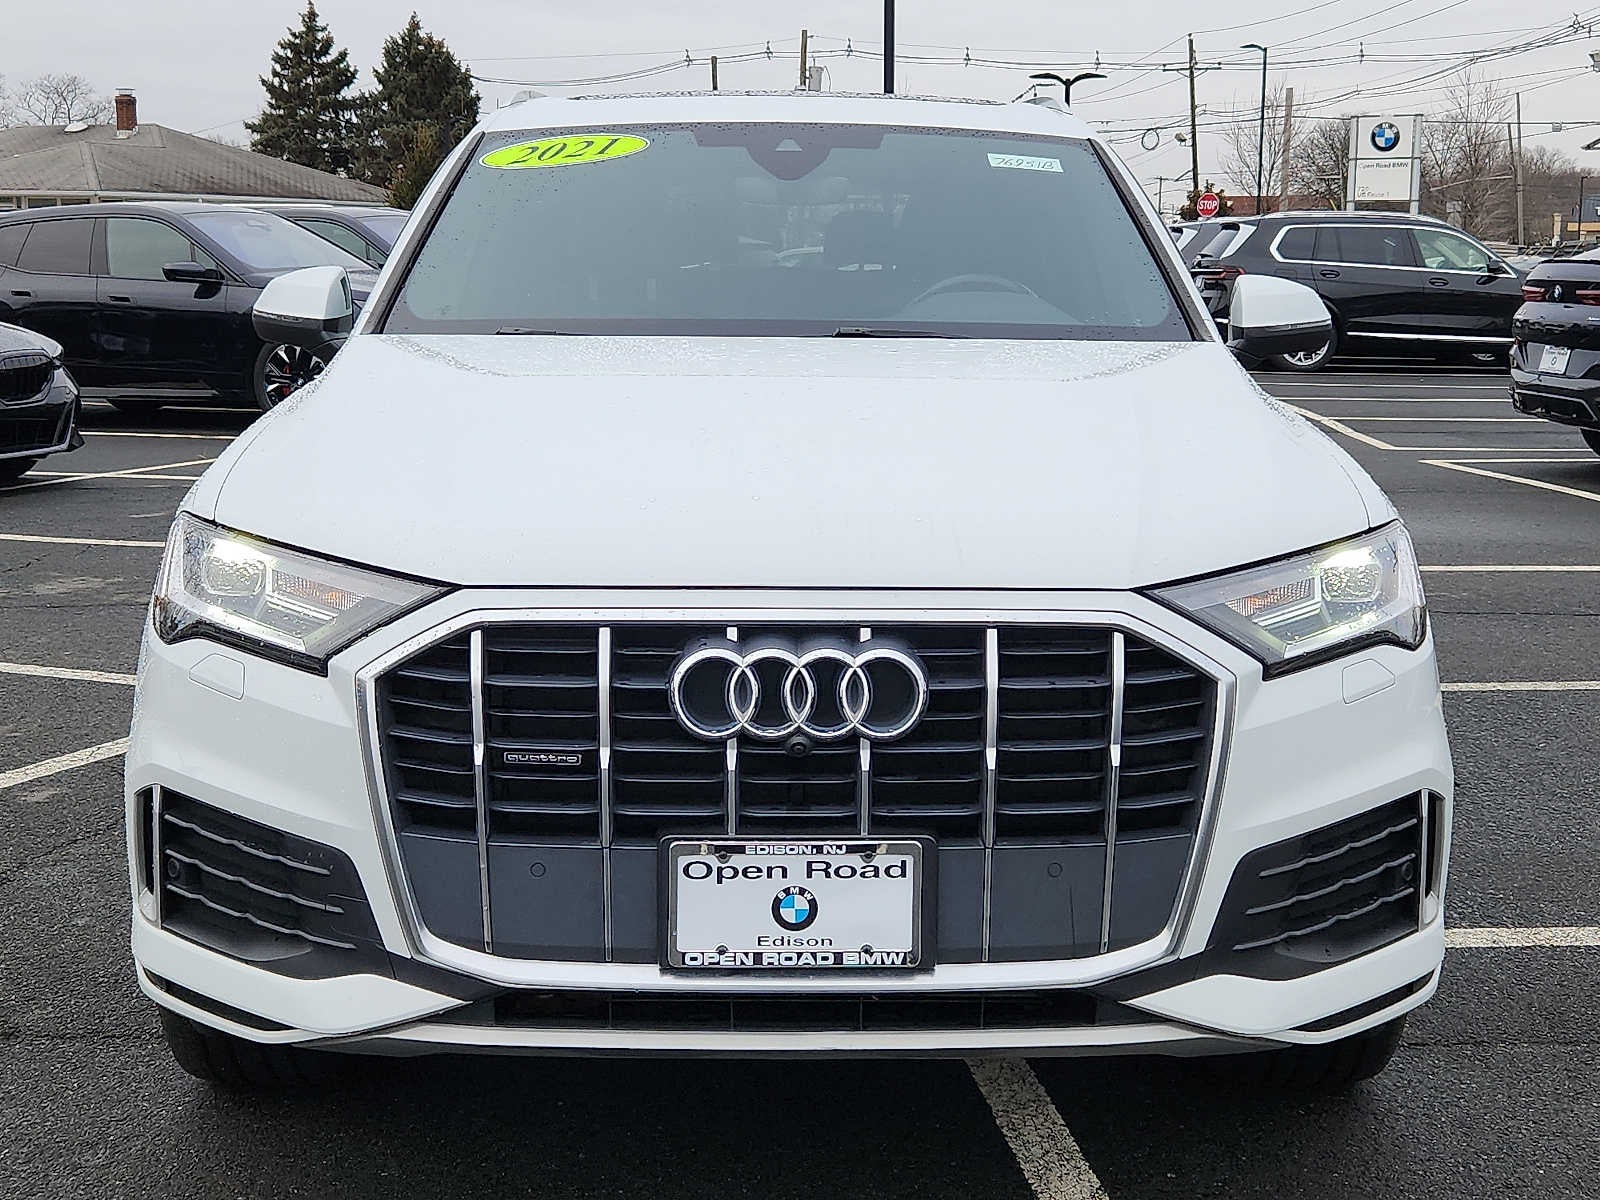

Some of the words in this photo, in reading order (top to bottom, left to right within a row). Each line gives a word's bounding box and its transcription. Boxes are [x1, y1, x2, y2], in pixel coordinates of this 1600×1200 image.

[506, 138, 621, 165] 2021
[1199, 200, 1218, 210] STOP
[507, 754, 578, 763] quattro
[745, 844, 817, 855] EDISON,
[823, 845, 847, 854] NJ
[682, 861, 788, 884] Open
[806, 860, 907, 879] Road
[777, 886, 814, 900] BMW
[757, 936, 833, 947] Edison
[684, 952, 754, 966] OPEN
[762, 952, 834, 966] ROAD
[842, 952, 905, 966] BMW
